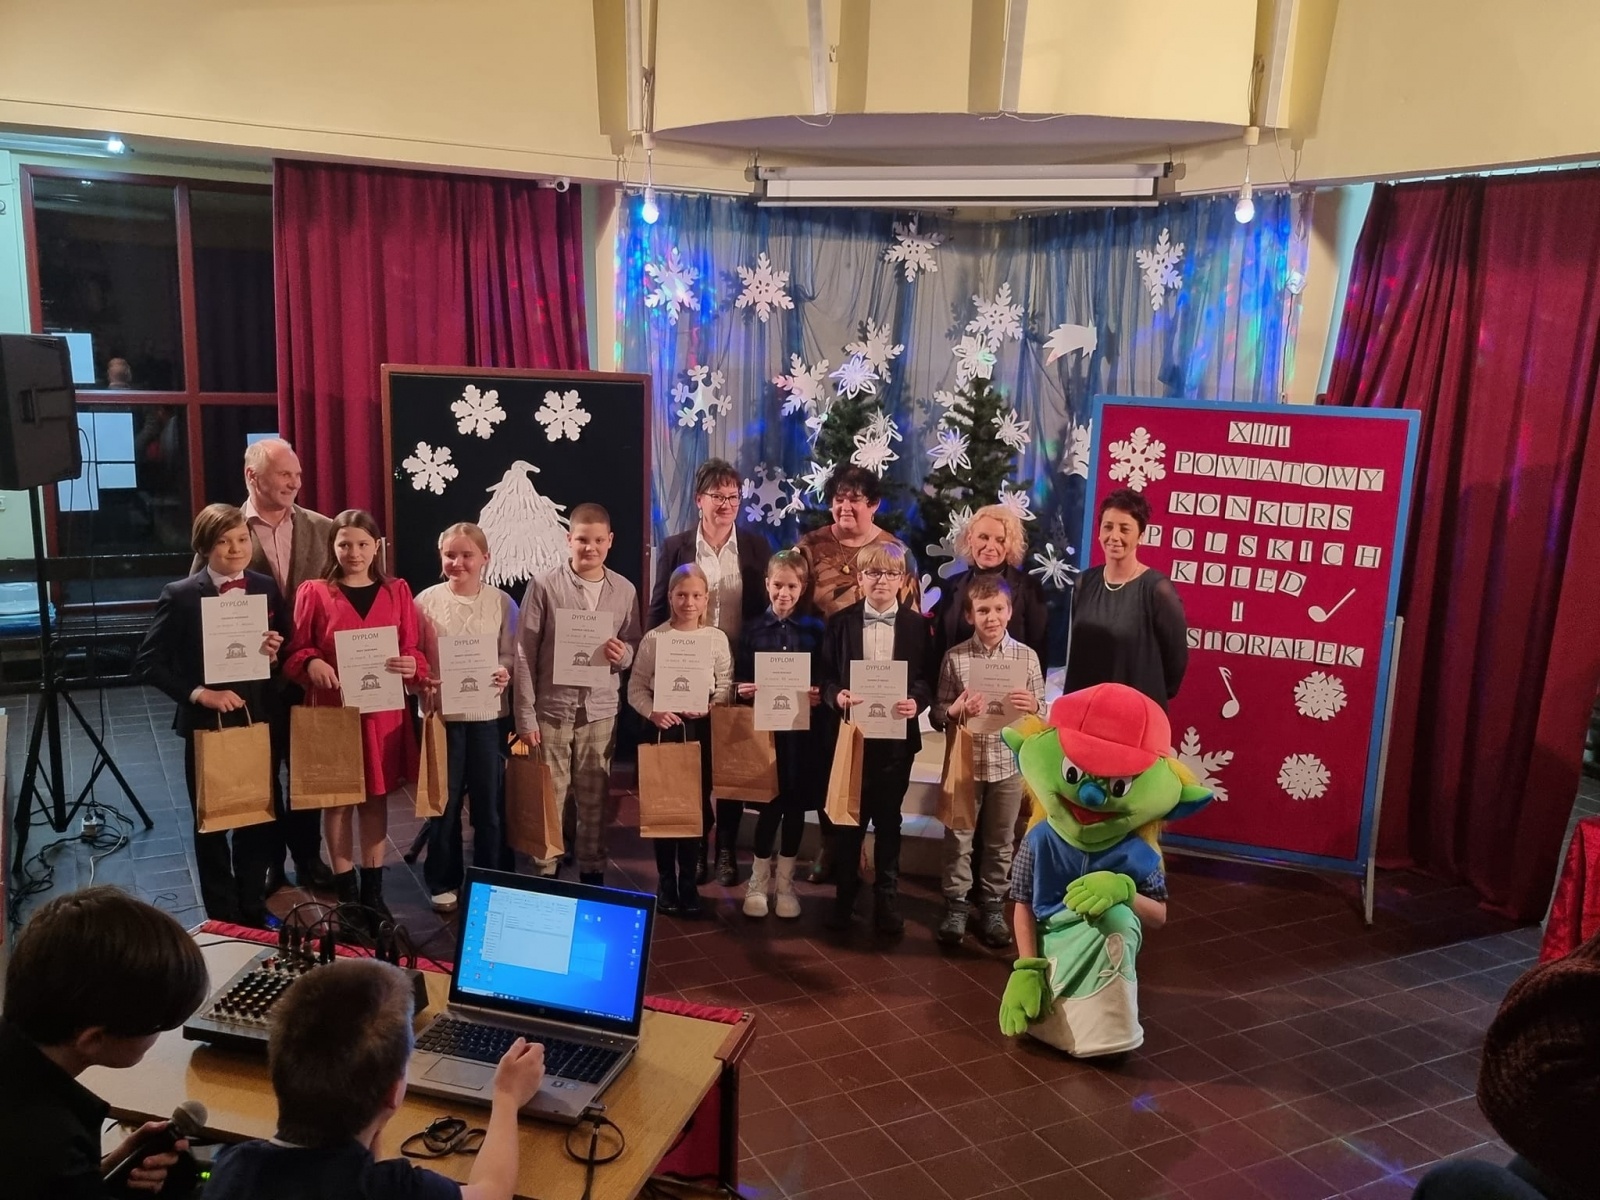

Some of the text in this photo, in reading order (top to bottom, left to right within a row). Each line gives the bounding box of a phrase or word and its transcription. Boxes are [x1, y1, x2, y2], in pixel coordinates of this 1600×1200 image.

[1230, 422, 1288, 447] XIII
[1177, 453, 1383, 491] POWIATOWY
[1173, 493, 1352, 529] KONKURS
[1147, 526, 1380, 567] POLSKICH
[220, 600, 249, 608] DYPLOM
[352, 633, 379, 641] DYPLOM
